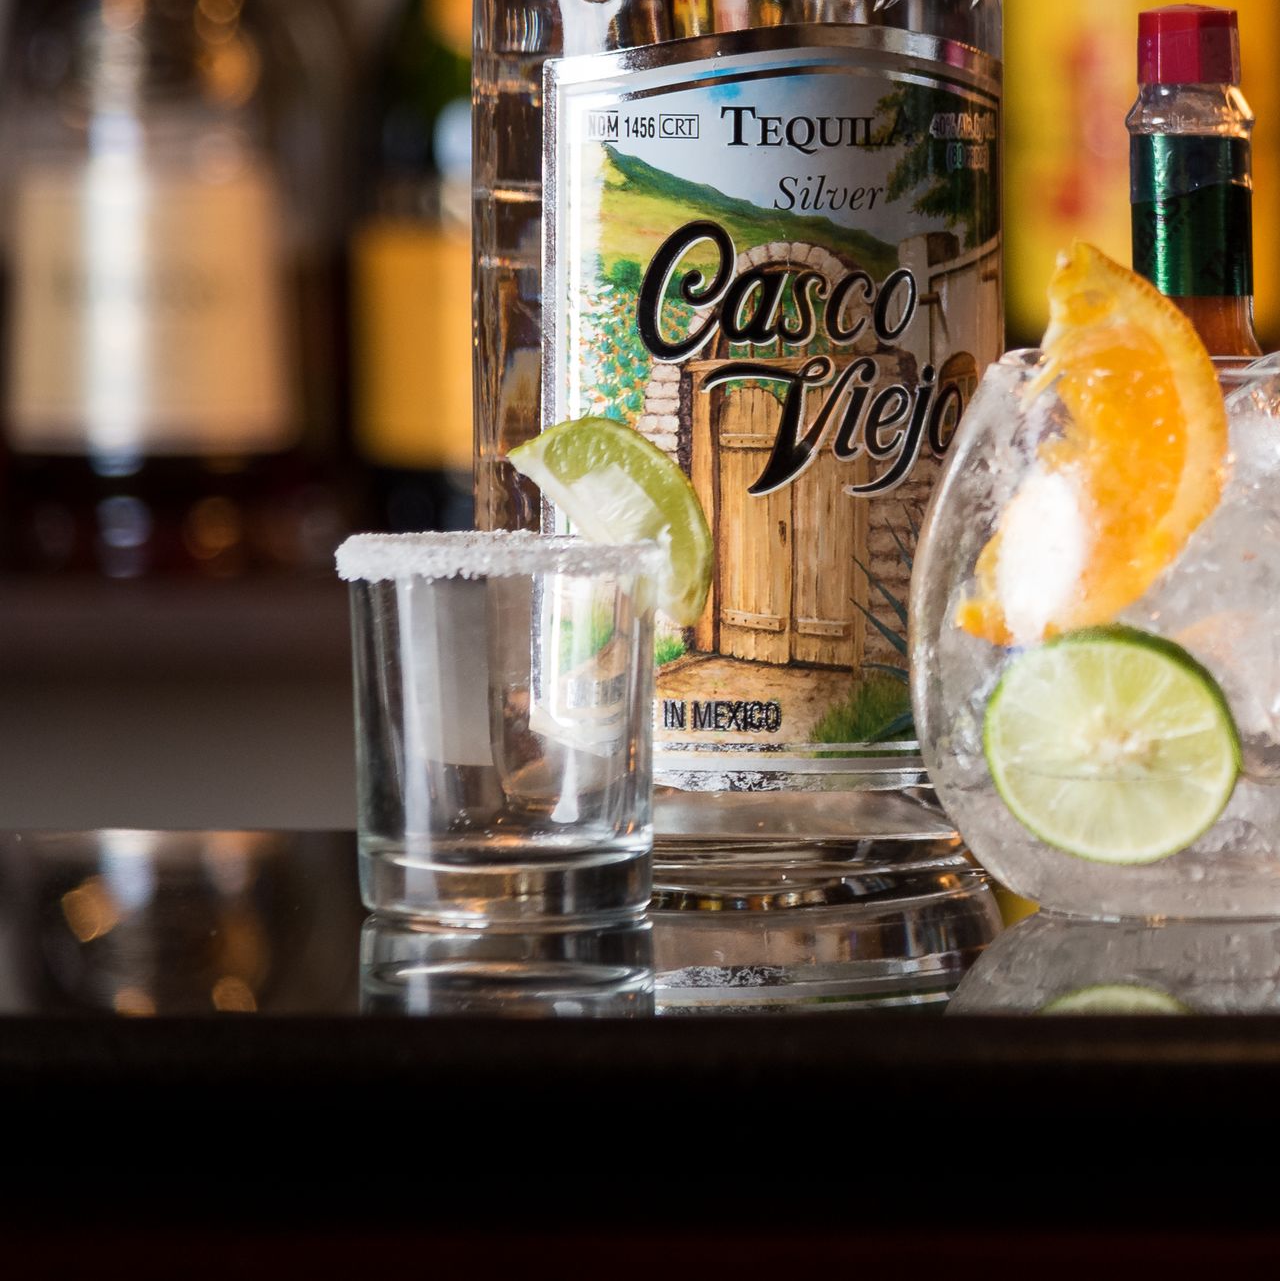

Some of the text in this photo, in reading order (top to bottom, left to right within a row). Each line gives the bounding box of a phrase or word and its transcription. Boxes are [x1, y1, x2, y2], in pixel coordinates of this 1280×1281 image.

[588, 115, 696, 138] NOM 1456 CRT
[774, 175, 886, 211] Silver
[636, 220, 917, 363] Casco
[702, 355, 964, 496] Viejo
[662, 699, 782, 733] IN MEXICO
